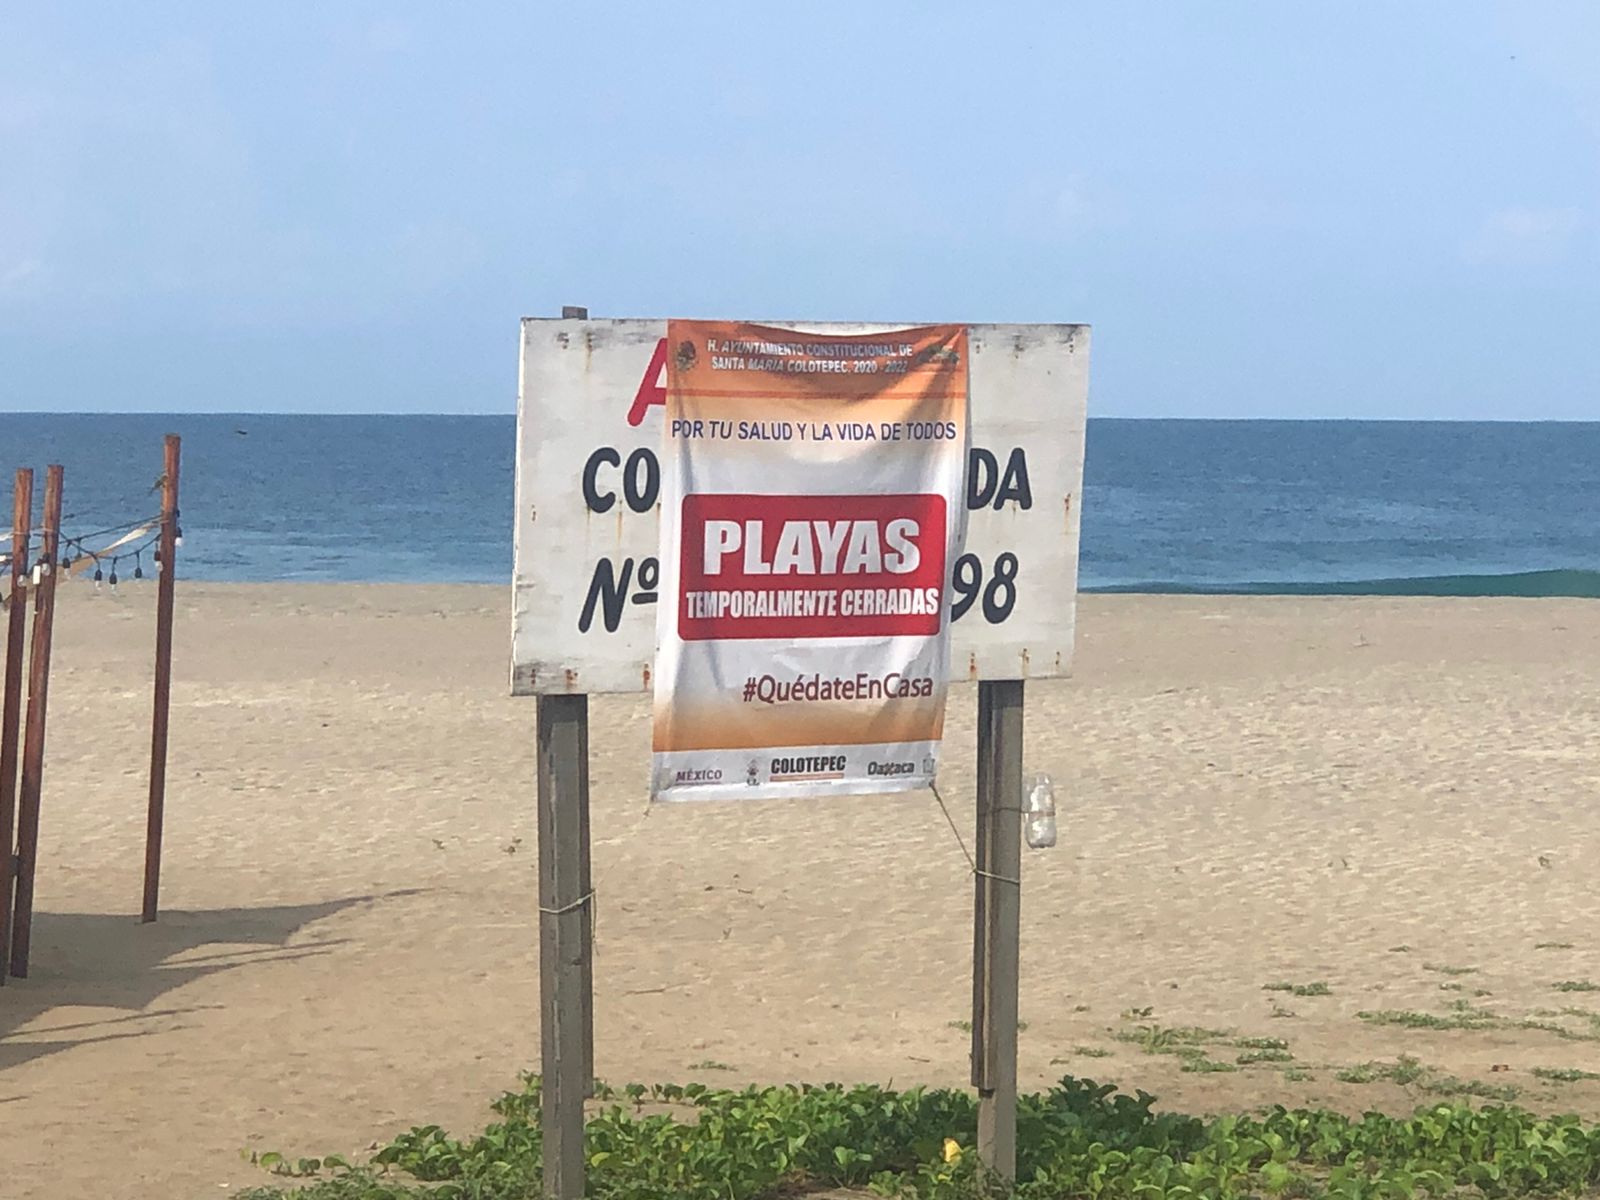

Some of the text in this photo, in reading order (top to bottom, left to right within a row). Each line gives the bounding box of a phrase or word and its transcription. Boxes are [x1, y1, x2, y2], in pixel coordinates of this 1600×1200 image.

[707, 339, 913, 357] H. AYUNTAMIENTO CONSTITUCIONAL DE
[712, 356, 745, 370] SANTA
[853, 360, 878, 374] 2020
[672, 420, 957, 441] POR TU SALUD Y LA VIDA DE TODOS
[582, 447, 1032, 513] CO DA
[703, 518, 921, 576] PLAYAS
[951, 552, 1019, 625] 98
[686, 587, 939, 619] TEMPORALMENTE CERRADAS
[742, 672, 934, 704] #QuédateEnCasa
[676, 767, 722, 782] MÉXICO
[771, 755, 847, 775] COLOTEPEC
